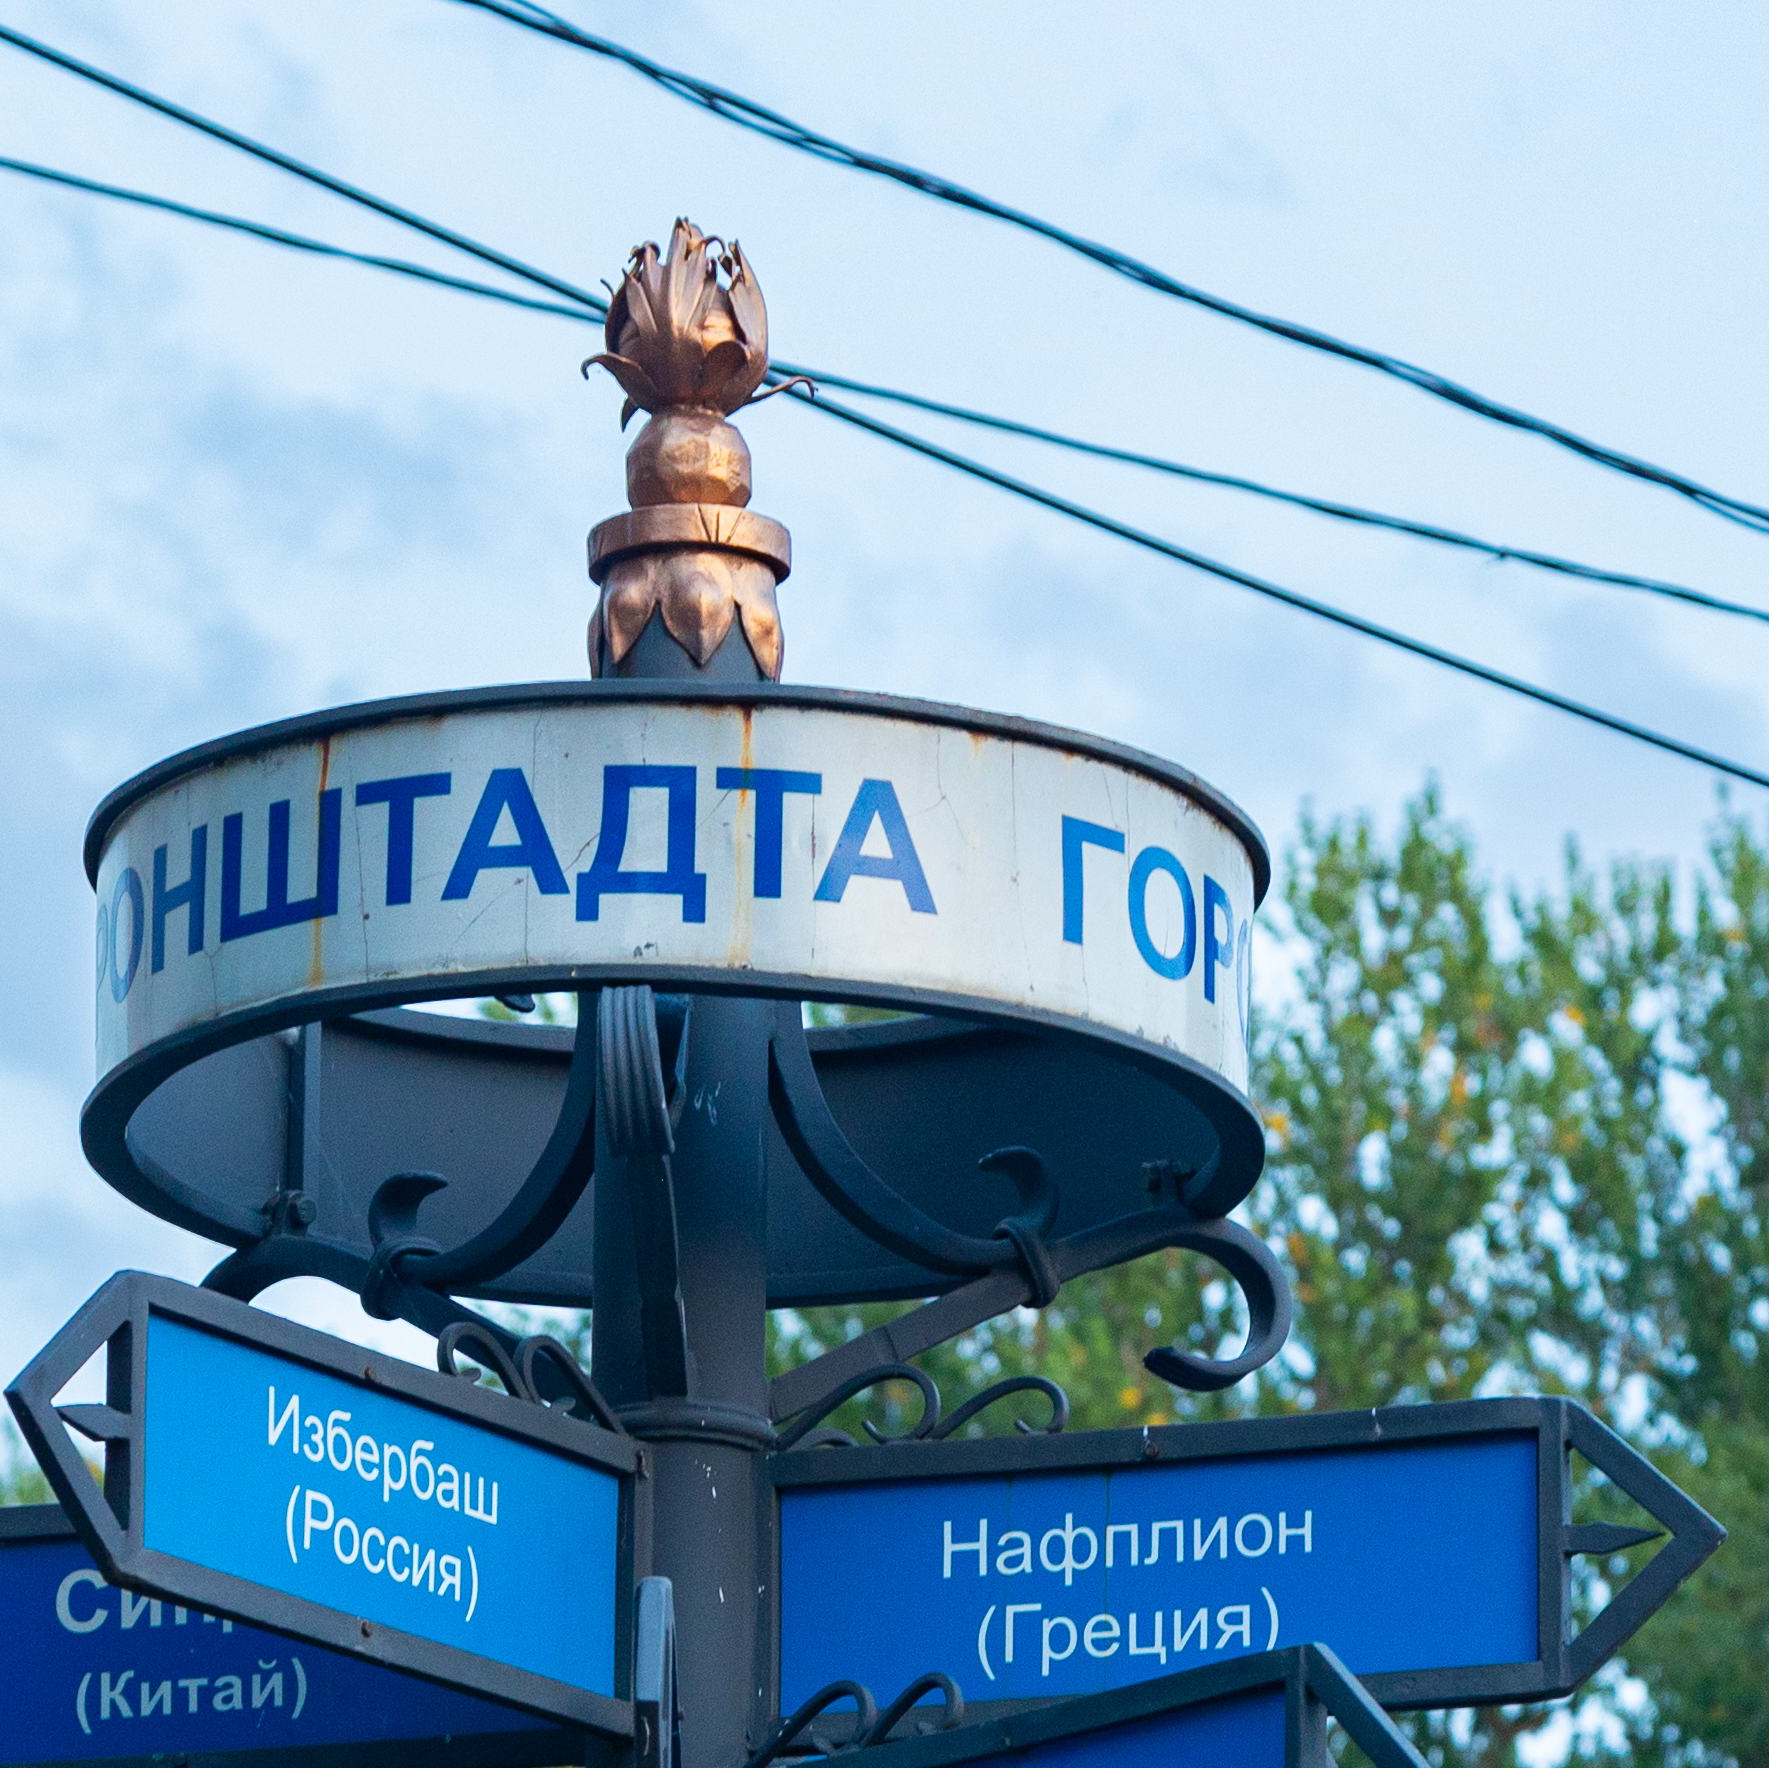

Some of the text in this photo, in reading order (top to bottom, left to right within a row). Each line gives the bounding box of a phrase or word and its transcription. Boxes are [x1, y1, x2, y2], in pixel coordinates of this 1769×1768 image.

[268, 1386, 498, 1524] Избербаш
[286, 1485, 480, 1623] (Россия)
[943, 1510, 1313, 1585] Нафплион
[978, 1587, 1279, 1680] (Греция)
[77, 1657, 307, 1734] (Китай)
